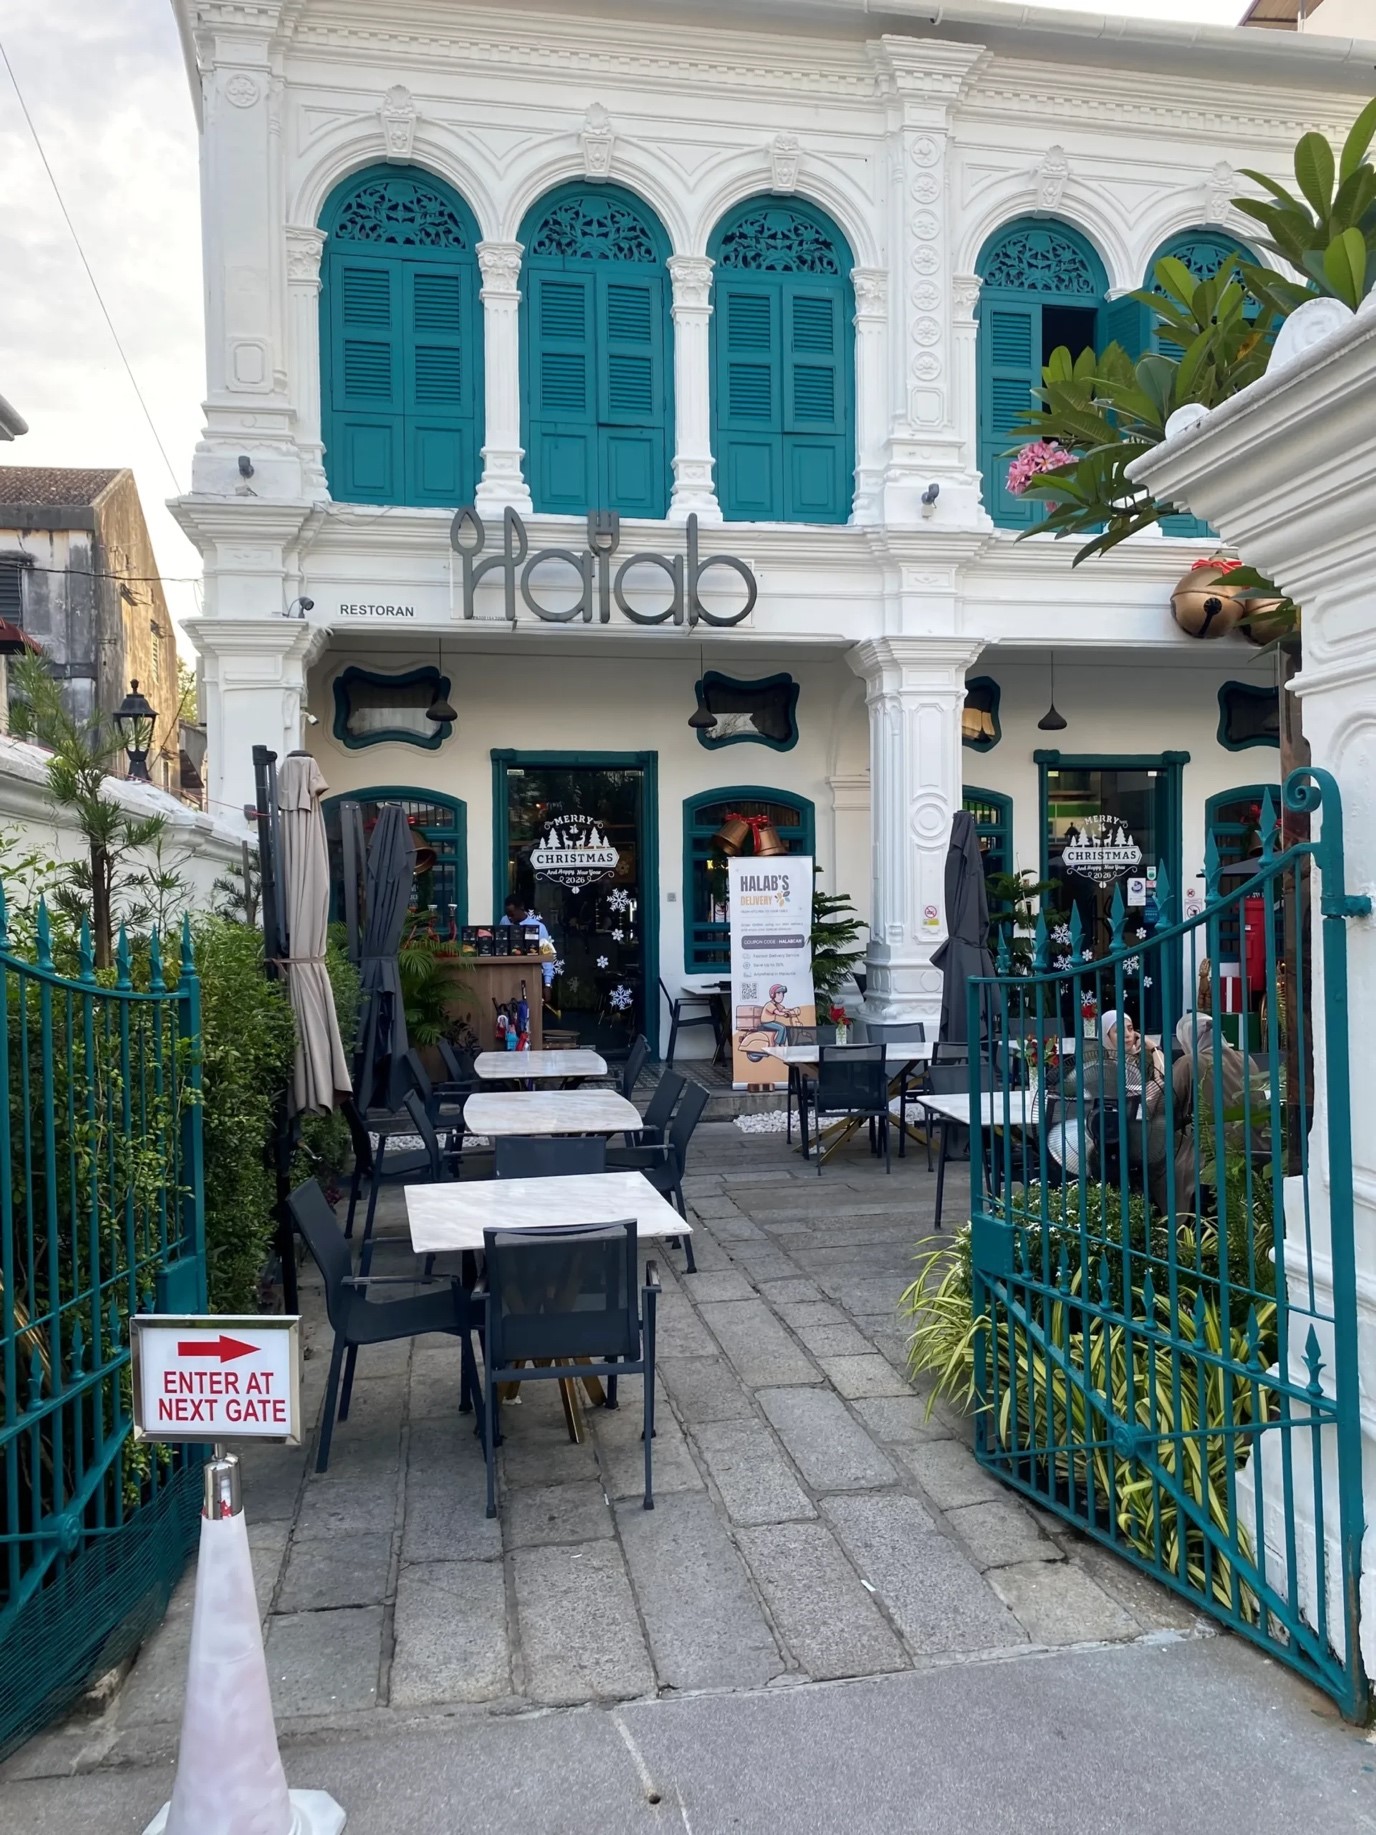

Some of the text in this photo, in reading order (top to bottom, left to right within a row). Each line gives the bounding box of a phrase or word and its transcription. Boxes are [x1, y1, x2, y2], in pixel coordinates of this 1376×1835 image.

[340, 603, 414, 617] RESTORAN
[554, 814, 594, 826] MERRY
[1084, 814, 1120, 826] MERRY
[536, 853, 613, 863] CHRISTMAS
[1067, 850, 1137, 861] CHRISTMAS
[565, 876, 585, 884] 2026
[740, 875, 789, 892] HALAB'S
[740, 895, 773, 906] DELIVERY
[163, 1371, 274, 1394] ENTER AT
[159, 1398, 287, 1422] NEXT GATE
